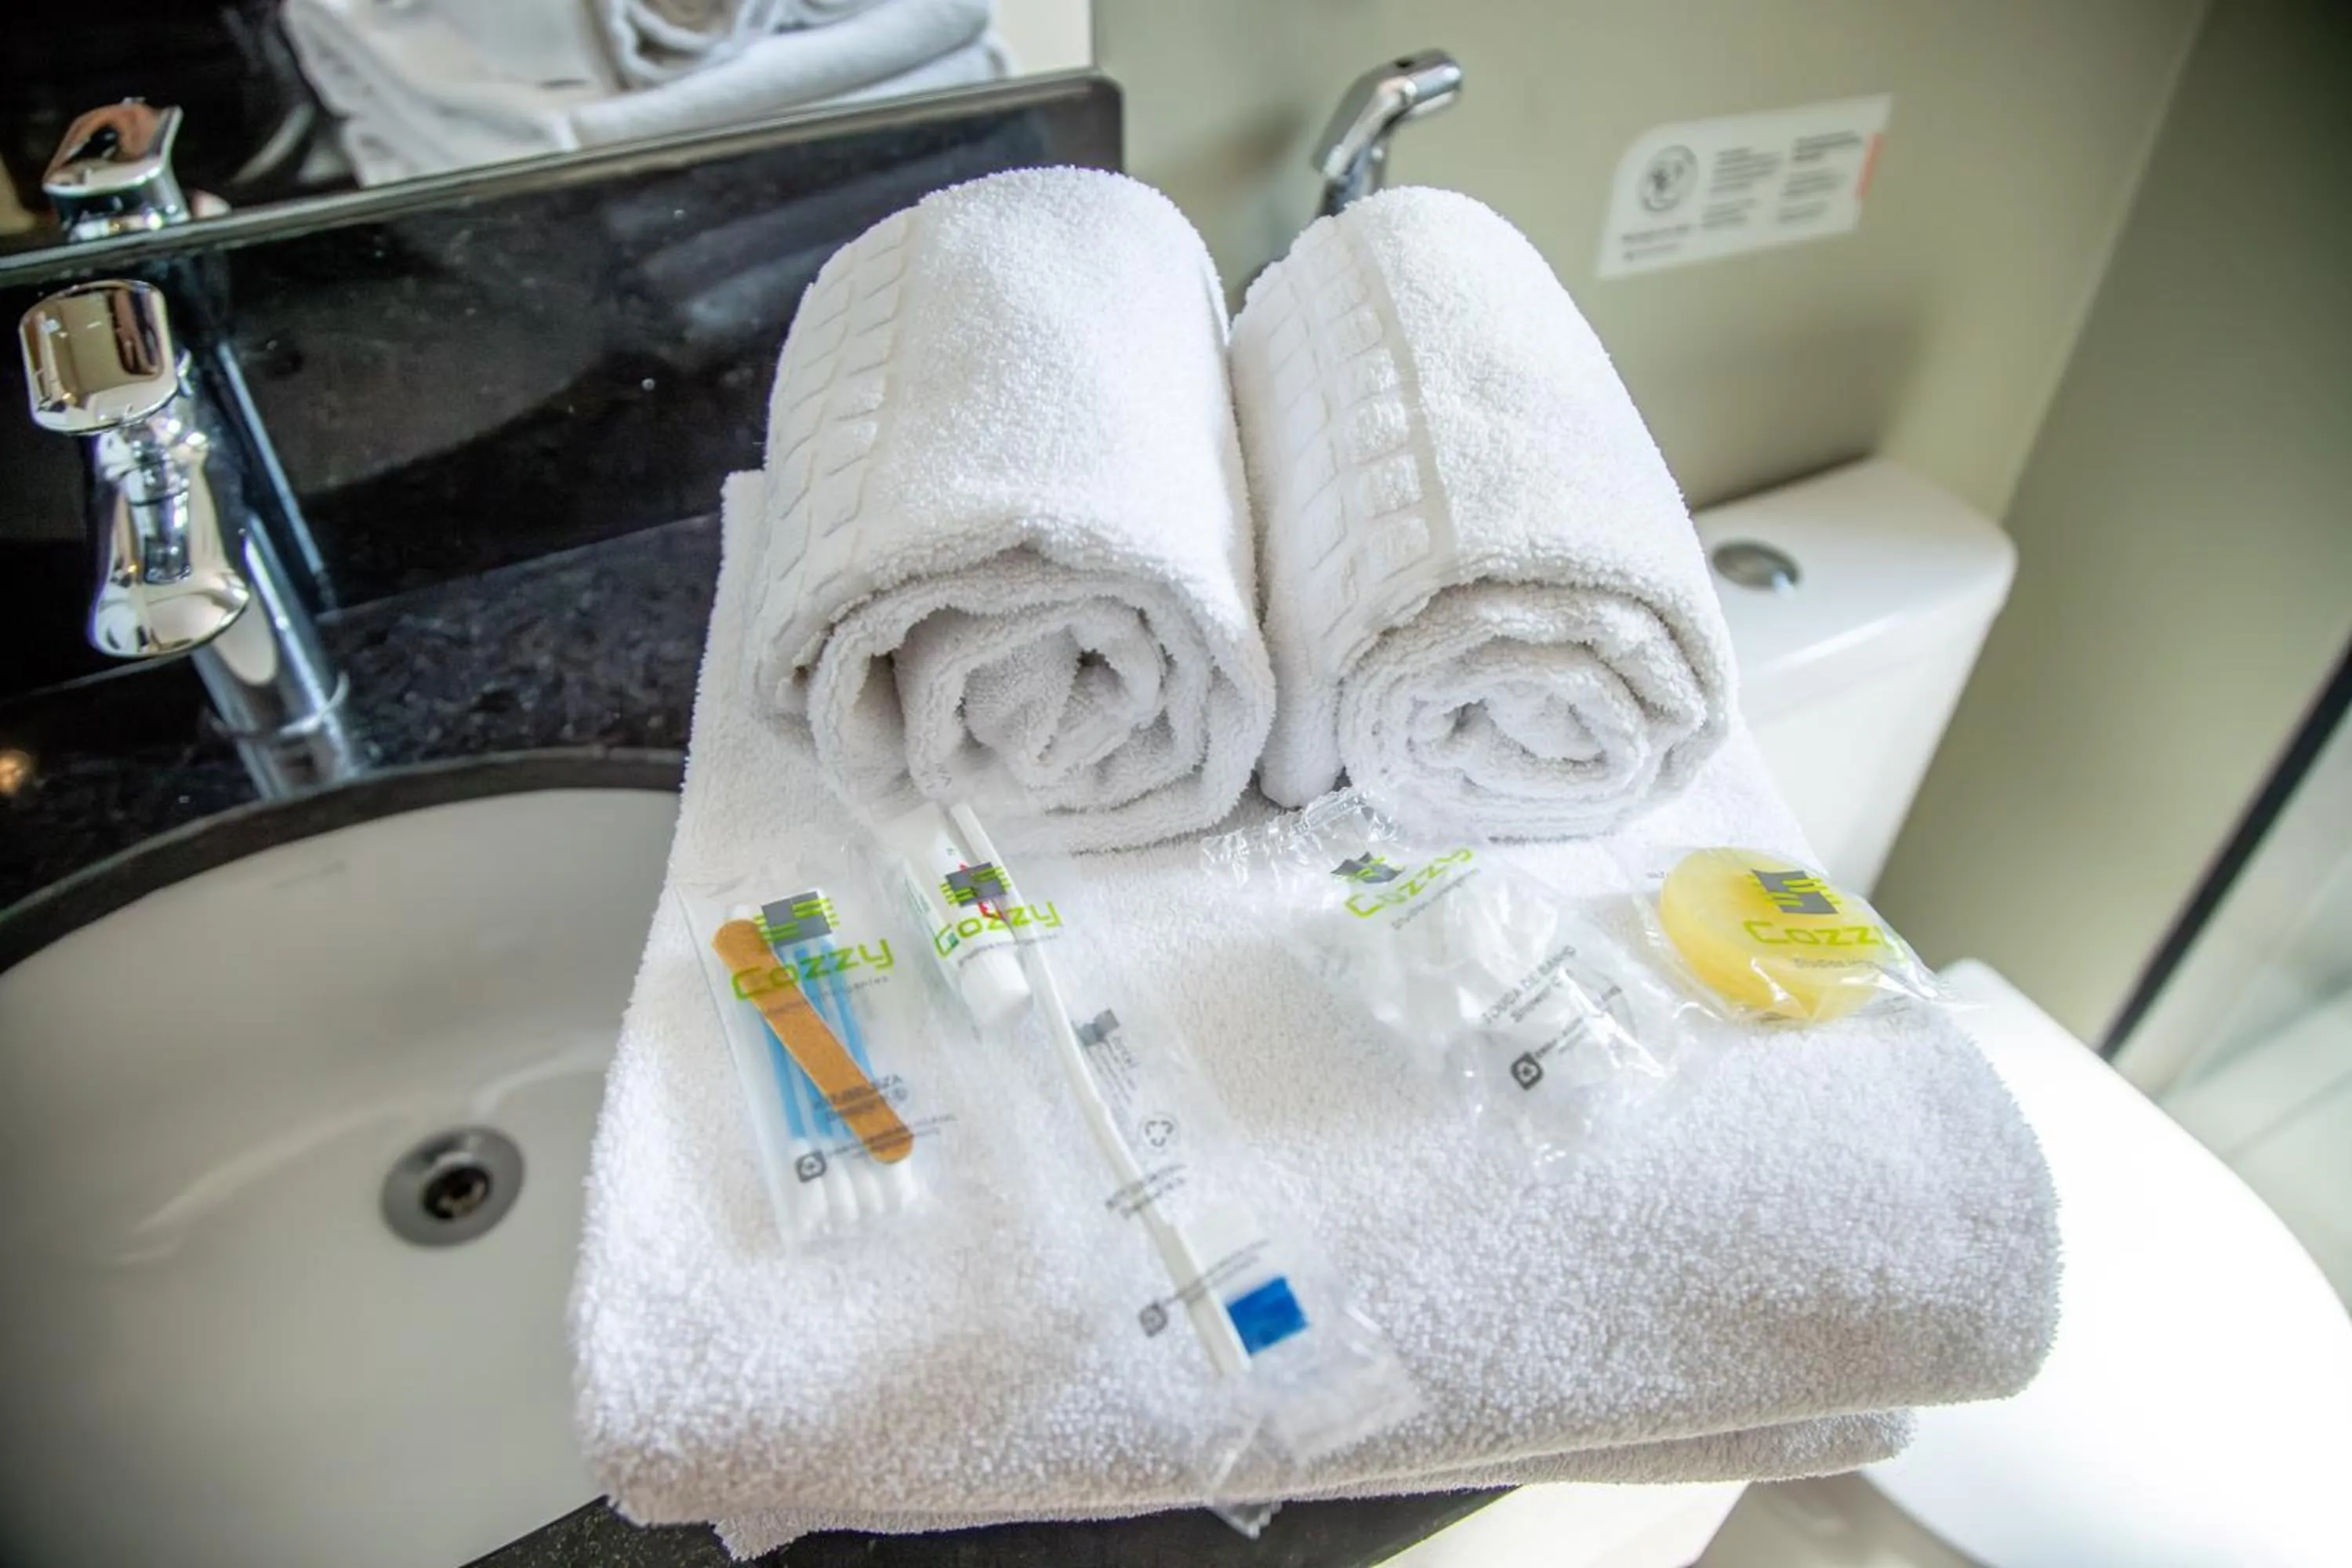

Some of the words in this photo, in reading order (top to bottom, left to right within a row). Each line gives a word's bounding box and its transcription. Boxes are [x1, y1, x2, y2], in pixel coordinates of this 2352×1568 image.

[1344, 848, 1473, 919] Cozzy
[731, 938, 895, 1000] Cozzy
[1743, 919, 1908, 969] Cozz
